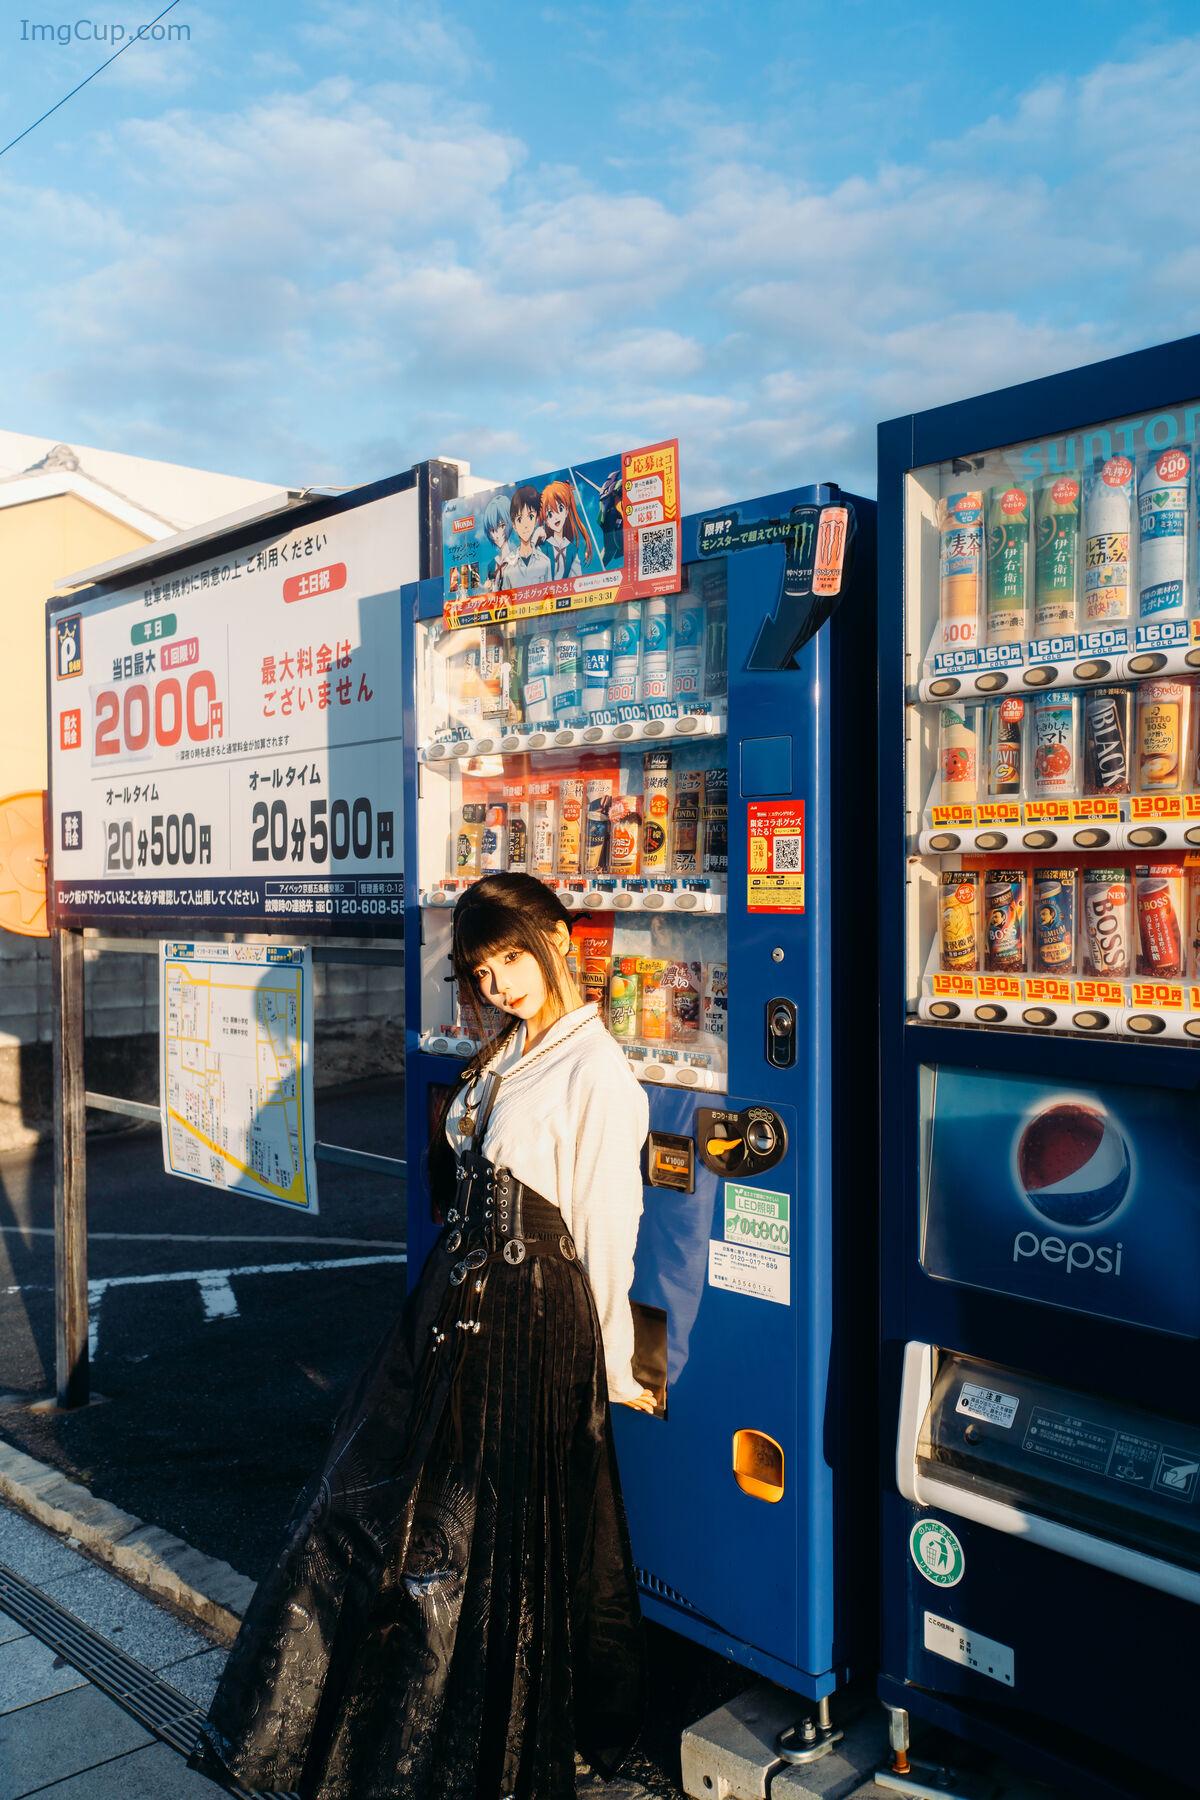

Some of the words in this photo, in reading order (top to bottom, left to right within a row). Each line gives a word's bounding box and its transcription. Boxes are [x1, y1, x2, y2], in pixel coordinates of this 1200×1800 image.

[1159, 458, 1186, 476] 600
[704, 519, 732, 537] 限界?
[952, 533, 981, 557] 麦茶
[1088, 536, 1119, 551] レモン
[246, 534, 327, 574] ご利用ください
[1053, 538, 1068, 588] 伊右衛門
[1003, 548, 1018, 596] 伊右衛門
[298, 571, 331, 596] 土日祝
[143, 620, 163, 640] 平日
[1137, 623, 1188, 642] 160円
[1030, 638, 1074, 654] 160円
[1080, 631, 1126, 648] 160円
[113, 649, 156, 681] 当日最大
[163, 642, 197, 666] 1回限り
[261, 639, 352, 686] 最大料金は
[936, 652, 976, 667] 160円
[979, 646, 1020, 662] 160円
[263, 672, 374, 717] ございません
[95, 669, 223, 757] 2000円
[1037, 730, 1068, 745] トマト
[1091, 706, 1126, 787] BLACK
[249, 764, 321, 791] オールタイム
[106, 783, 159, 806] オールタイム
[933, 805, 973, 821] 140円
[977, 804, 1018, 820] 140円
[1025, 802, 1069, 818] 140円
[1073, 799, 1118, 815] 120円
[1131, 796, 1181, 812] 130円
[65, 815, 79, 830] 基本
[252, 797, 394, 865] 20分500円
[107, 812, 211, 871] 20分500円
[58, 889, 259, 907] ロック板が下がっていることを必ず確認して入出庫してください
[1143, 895, 1169, 911] BOSS
[1093, 899, 1126, 966] BOSS
[934, 975, 973, 990] 130円
[978, 977, 1019, 992] 130円
[1026, 979, 1069, 996] 130円
[1076, 982, 1121, 999] 130円
[1133, 984, 1181, 1001] 130円
[738, 1198, 776, 1217] LED照明
[1013, 1231, 1123, 1276] pepsi
[920, 1560, 955, 1585] リサイクル
